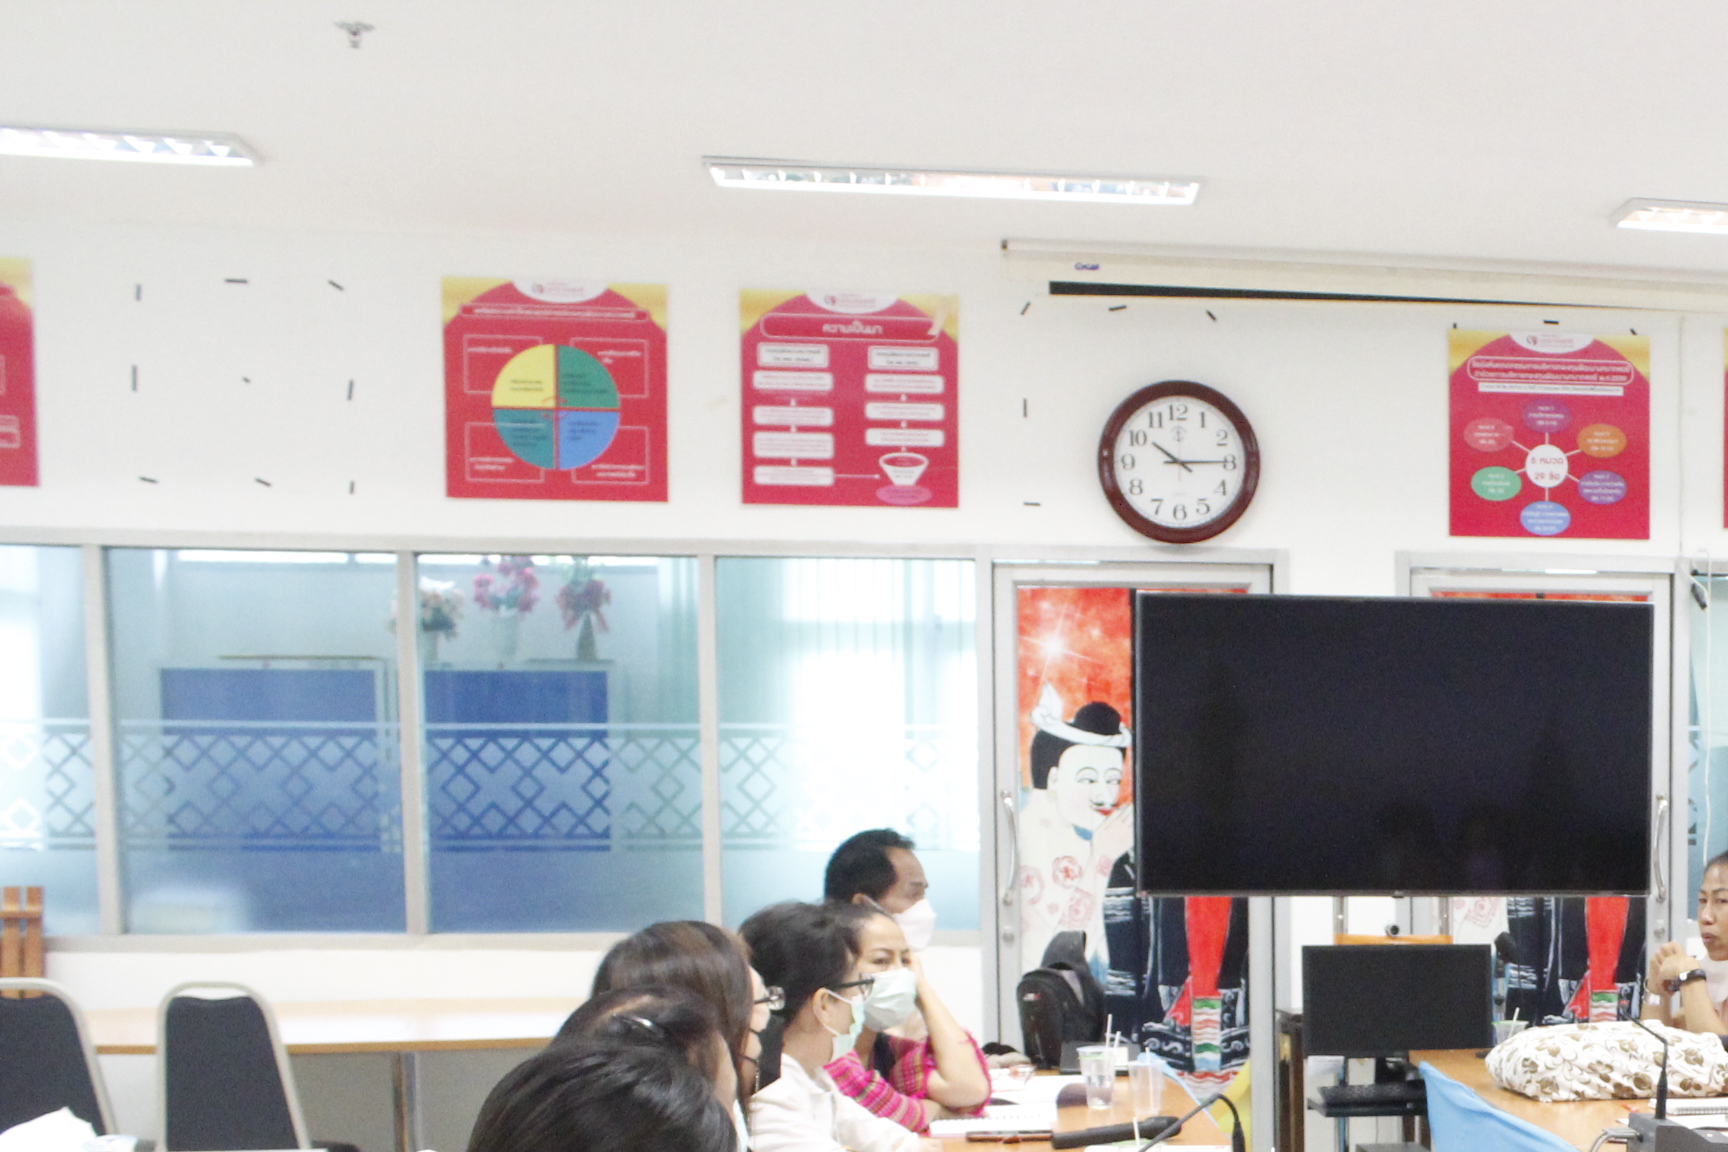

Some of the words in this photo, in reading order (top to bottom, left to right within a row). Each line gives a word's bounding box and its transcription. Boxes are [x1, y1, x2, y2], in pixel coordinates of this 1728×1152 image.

[1148, 411, 1163, 428] 11
[1168, 404, 1188, 421] 12
[1199, 411, 1206, 428] 1
[1129, 430, 1147, 446] 10
[1217, 430, 1228, 447] 2
[1121, 454, 1135, 470] 9
[1223, 454, 1236, 471] 3
[1129, 478, 1143, 495] 8
[1214, 479, 1227, 496] 4
[1151, 498, 1164, 515] 7
[1173, 503, 1187, 520] 6
[1196, 498, 1210, 515] 5
